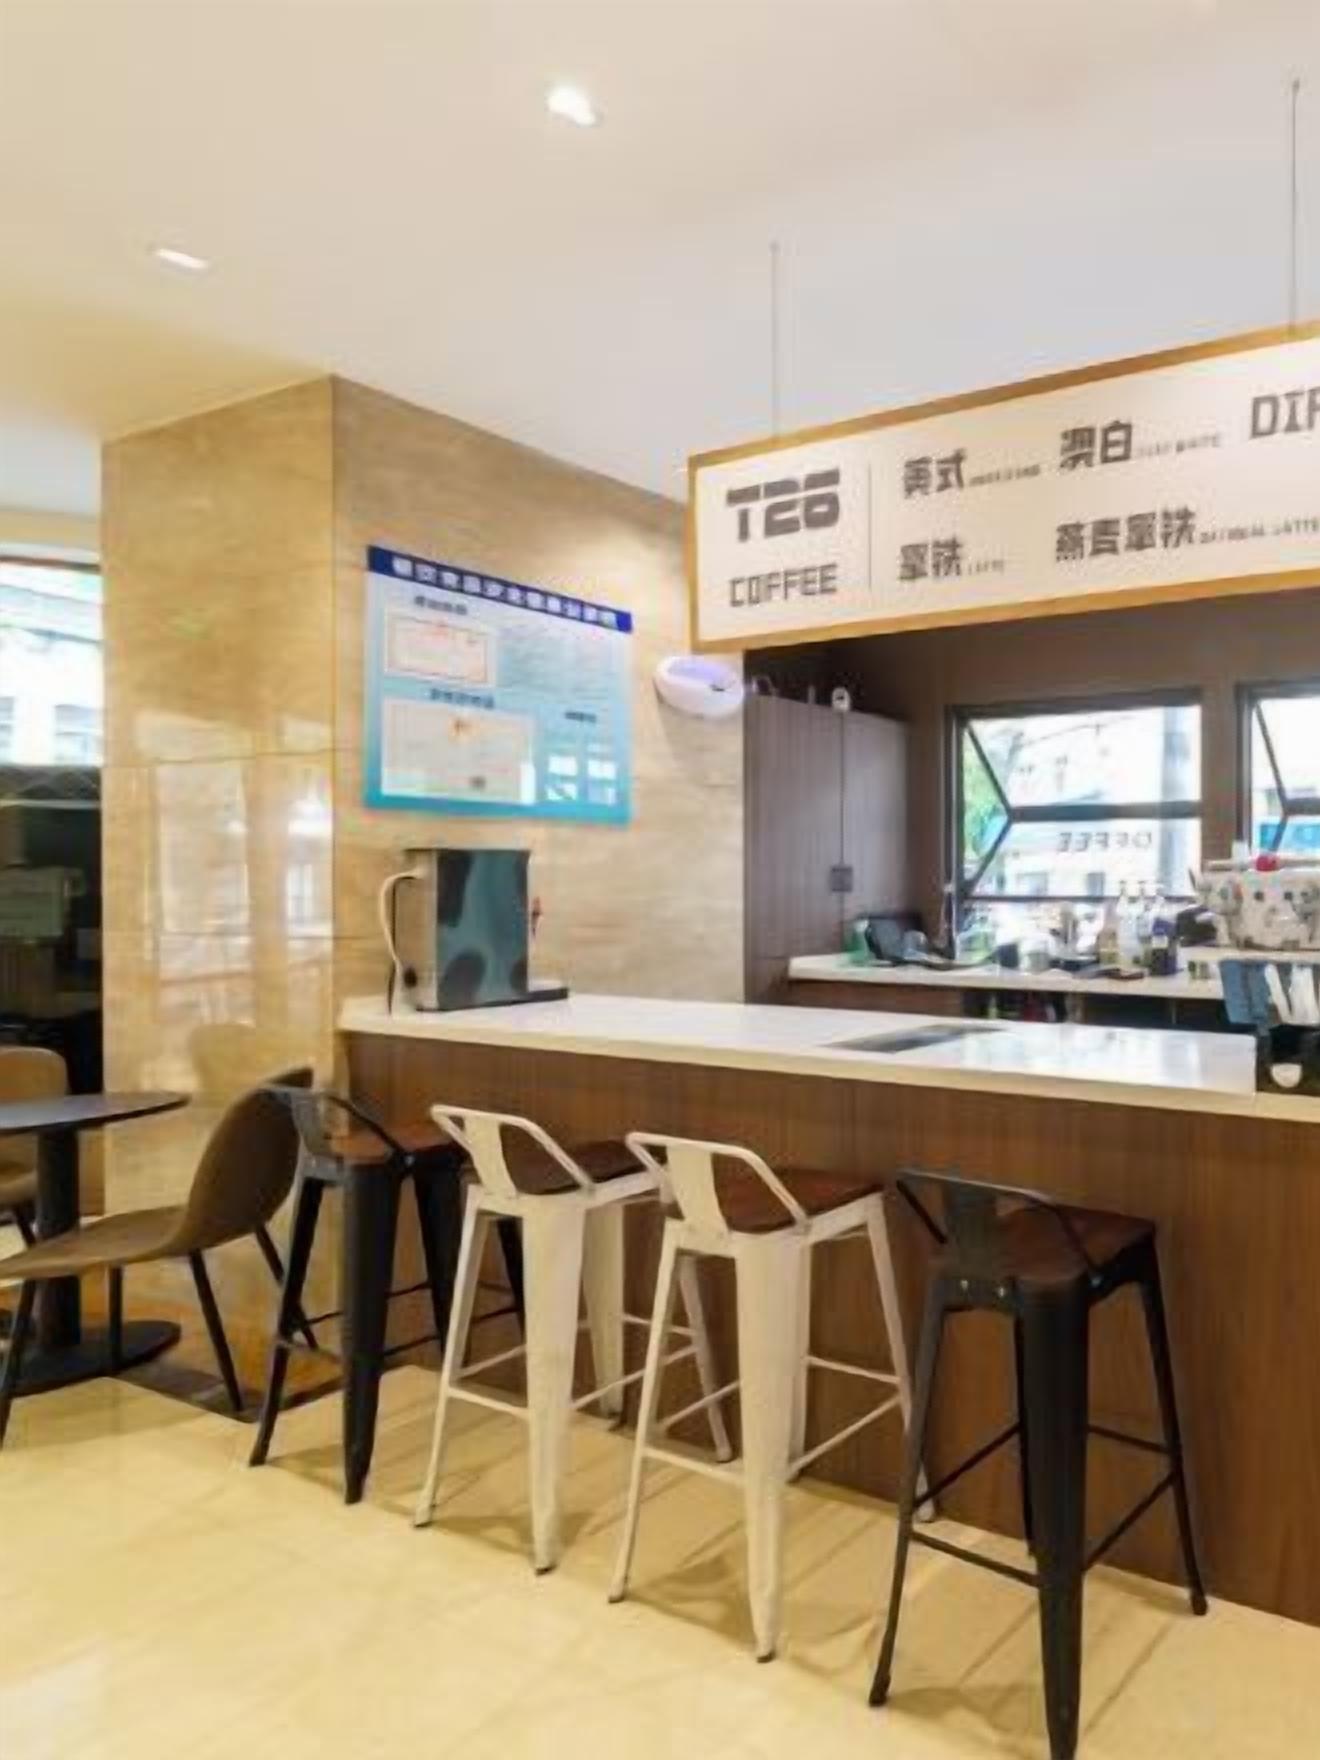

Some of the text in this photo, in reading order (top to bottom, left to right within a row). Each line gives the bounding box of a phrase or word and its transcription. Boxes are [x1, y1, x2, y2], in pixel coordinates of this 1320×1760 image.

[1059, 420, 1133, 469] 澳白
[903, 449, 966, 499] 美式
[726, 468, 840, 543] T26
[899, 537, 963, 581] 拿铁
[1056, 507, 1196, 563] 燕麦拿铁
[729, 562, 838, 608] COFFEE
